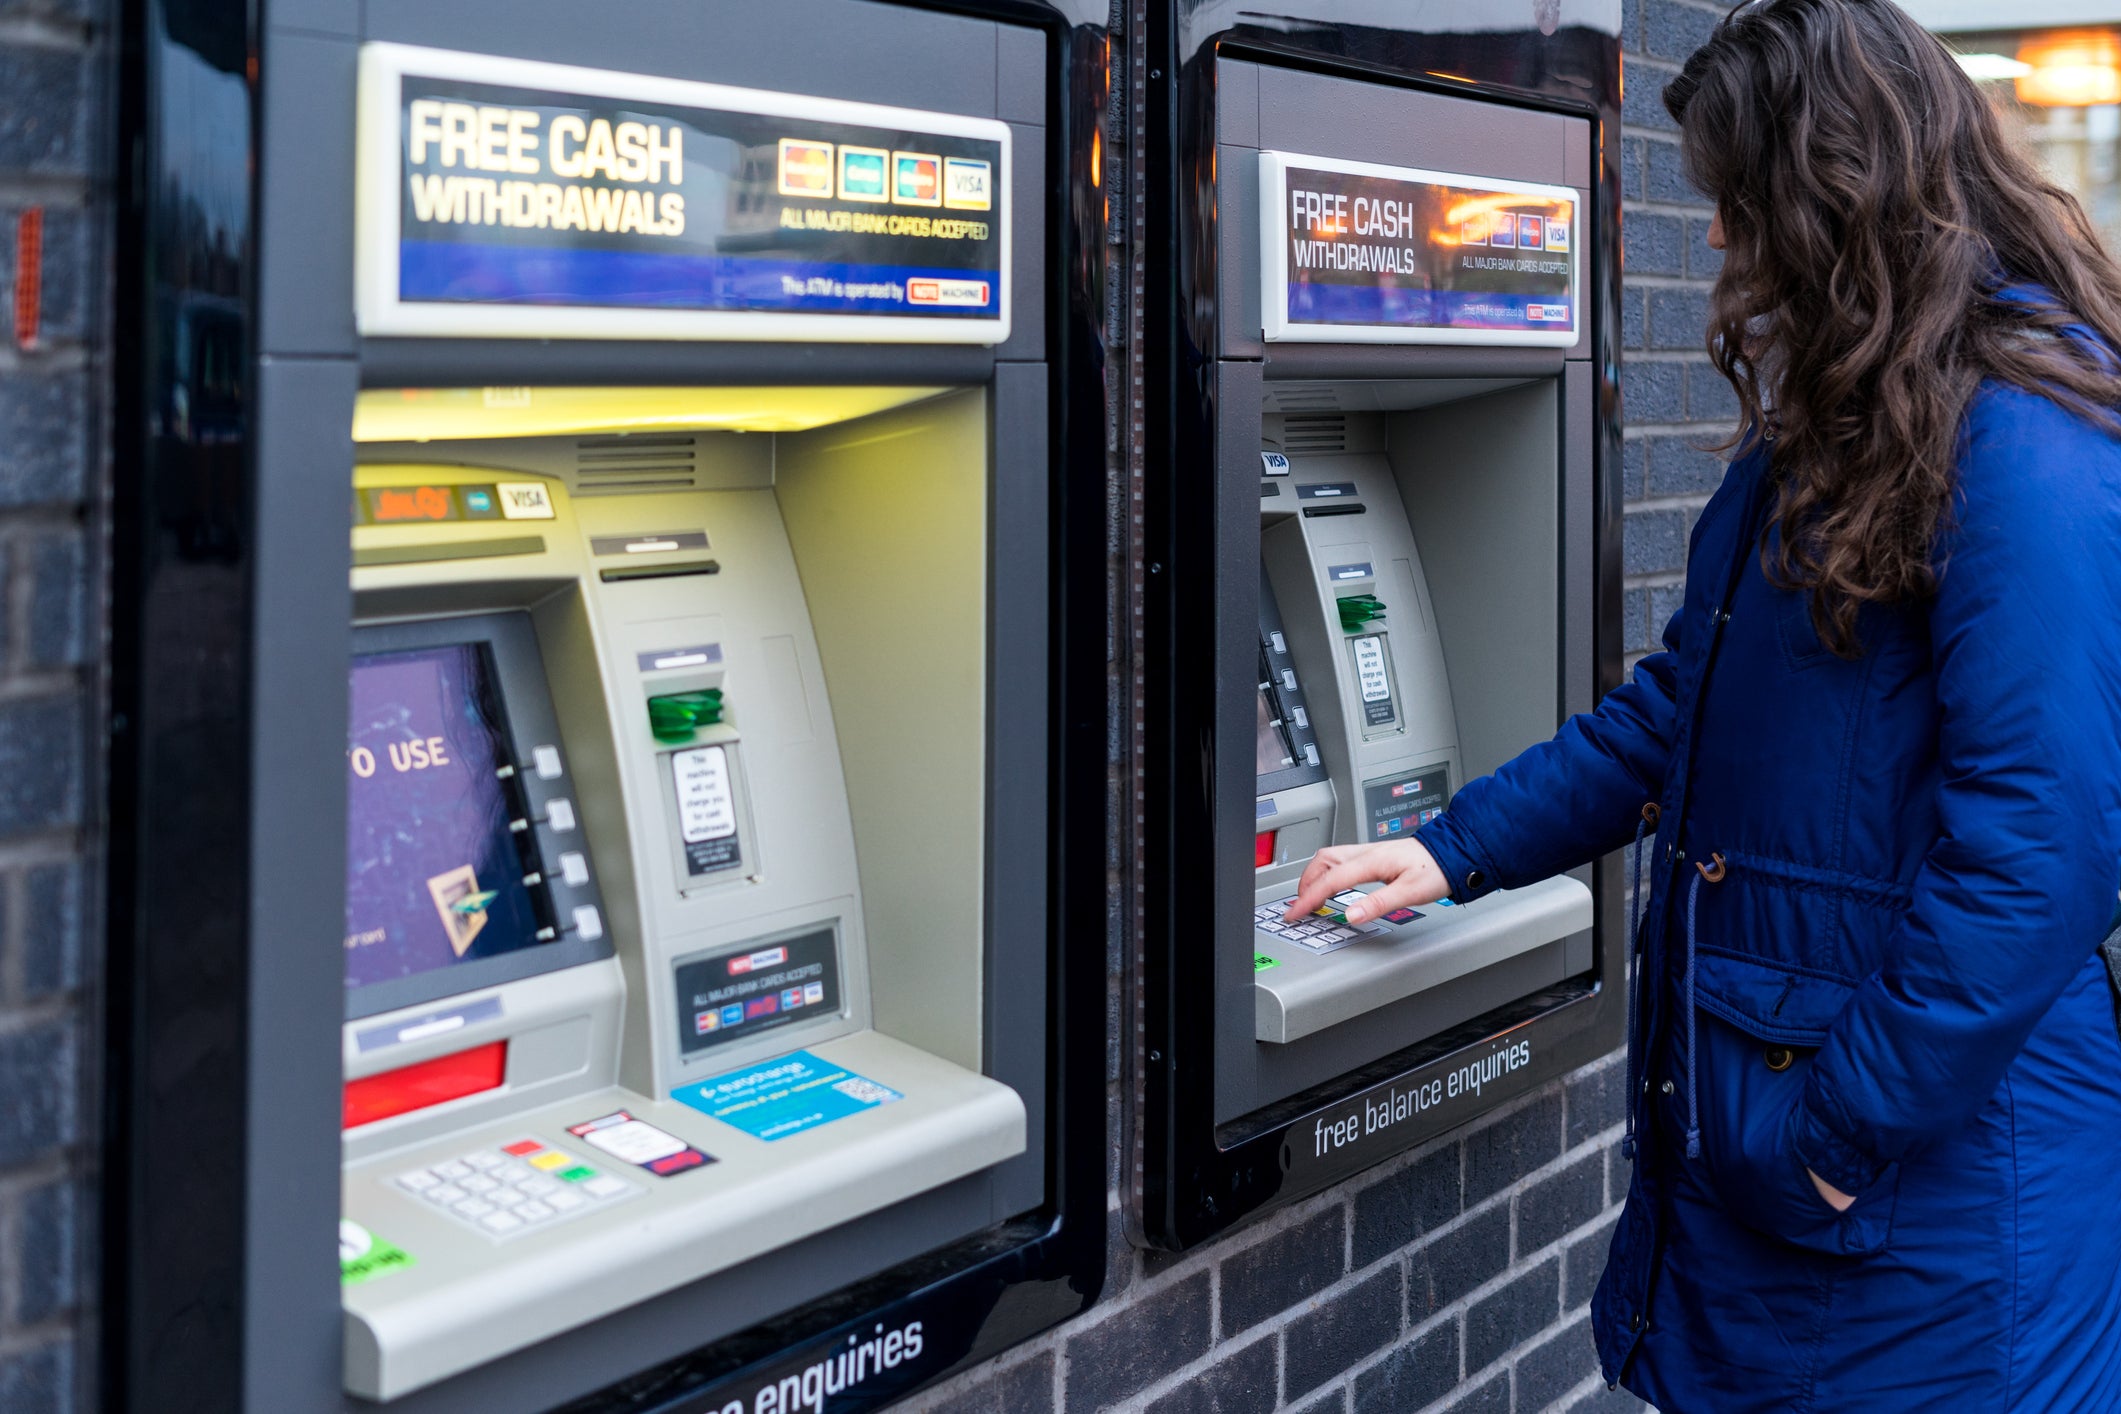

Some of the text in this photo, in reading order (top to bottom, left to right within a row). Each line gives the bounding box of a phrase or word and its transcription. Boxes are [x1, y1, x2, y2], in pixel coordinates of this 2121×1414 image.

[410, 99, 683, 186] FREE CASH
[954, 174, 984, 193] VISA
[410, 173, 685, 236] WITHDRAWALS
[1293, 190, 1412, 239] FREE CASH
[780, 207, 989, 240] ALL MAJOR BANK CARDS ACCEPTED
[1549, 227, 1566, 242] VISA
[1293, 239, 1414, 274] WITHDRAWALS
[1462, 256, 1568, 274] ALL MAJOR BANK CARDS ACCEPTED
[781, 276, 805, 296] This
[806, 277, 833, 297] ATM
[834, 281, 843, 297] is
[844, 281, 890, 302] operated
[891, 282, 905, 303] by
[1464, 304, 1475, 315] This
[1476, 305, 1488, 317] ATM
[1494, 307, 1517, 319] operated
[1517, 308, 1524, 319] by
[1530, 308, 1542, 318] NOTE
[1544, 307, 1564, 318] MACHINE
[1264, 455, 1287, 467] VISA
[509, 491, 544, 508] VISA
[1361, 651, 1377, 659] machine
[347, 736, 450, 778] O USE
[1314, 1039, 1530, 1157] free balance enquiries
[755, 1321, 923, 1414] enquiries
